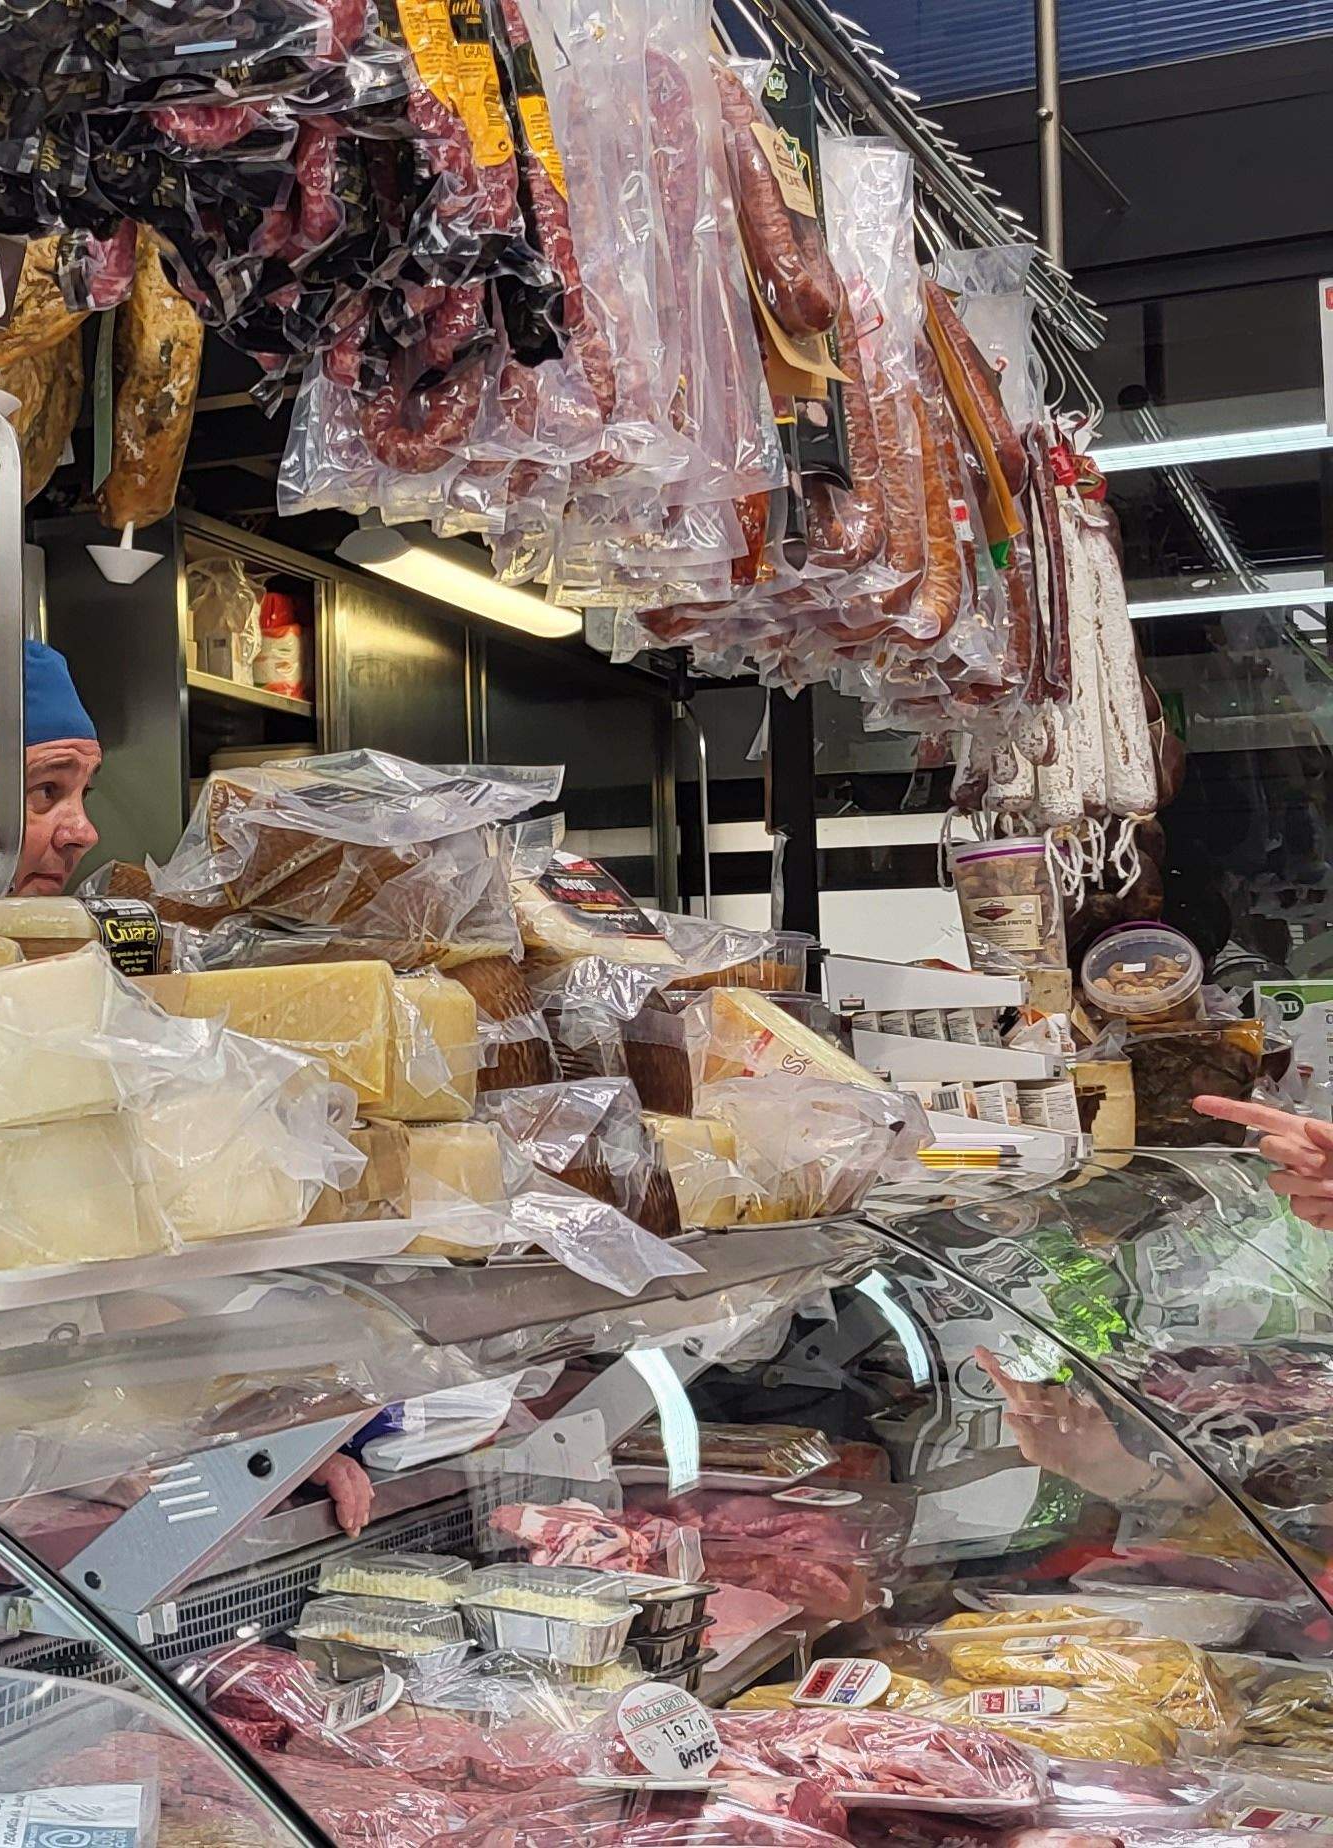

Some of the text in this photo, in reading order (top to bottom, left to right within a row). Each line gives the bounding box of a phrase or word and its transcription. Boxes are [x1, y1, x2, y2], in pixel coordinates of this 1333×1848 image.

[105, 919, 156, 943] Guara
[660, 1693, 689, 1713] BROTO
[678, 1740, 719, 1770] BISTEC
